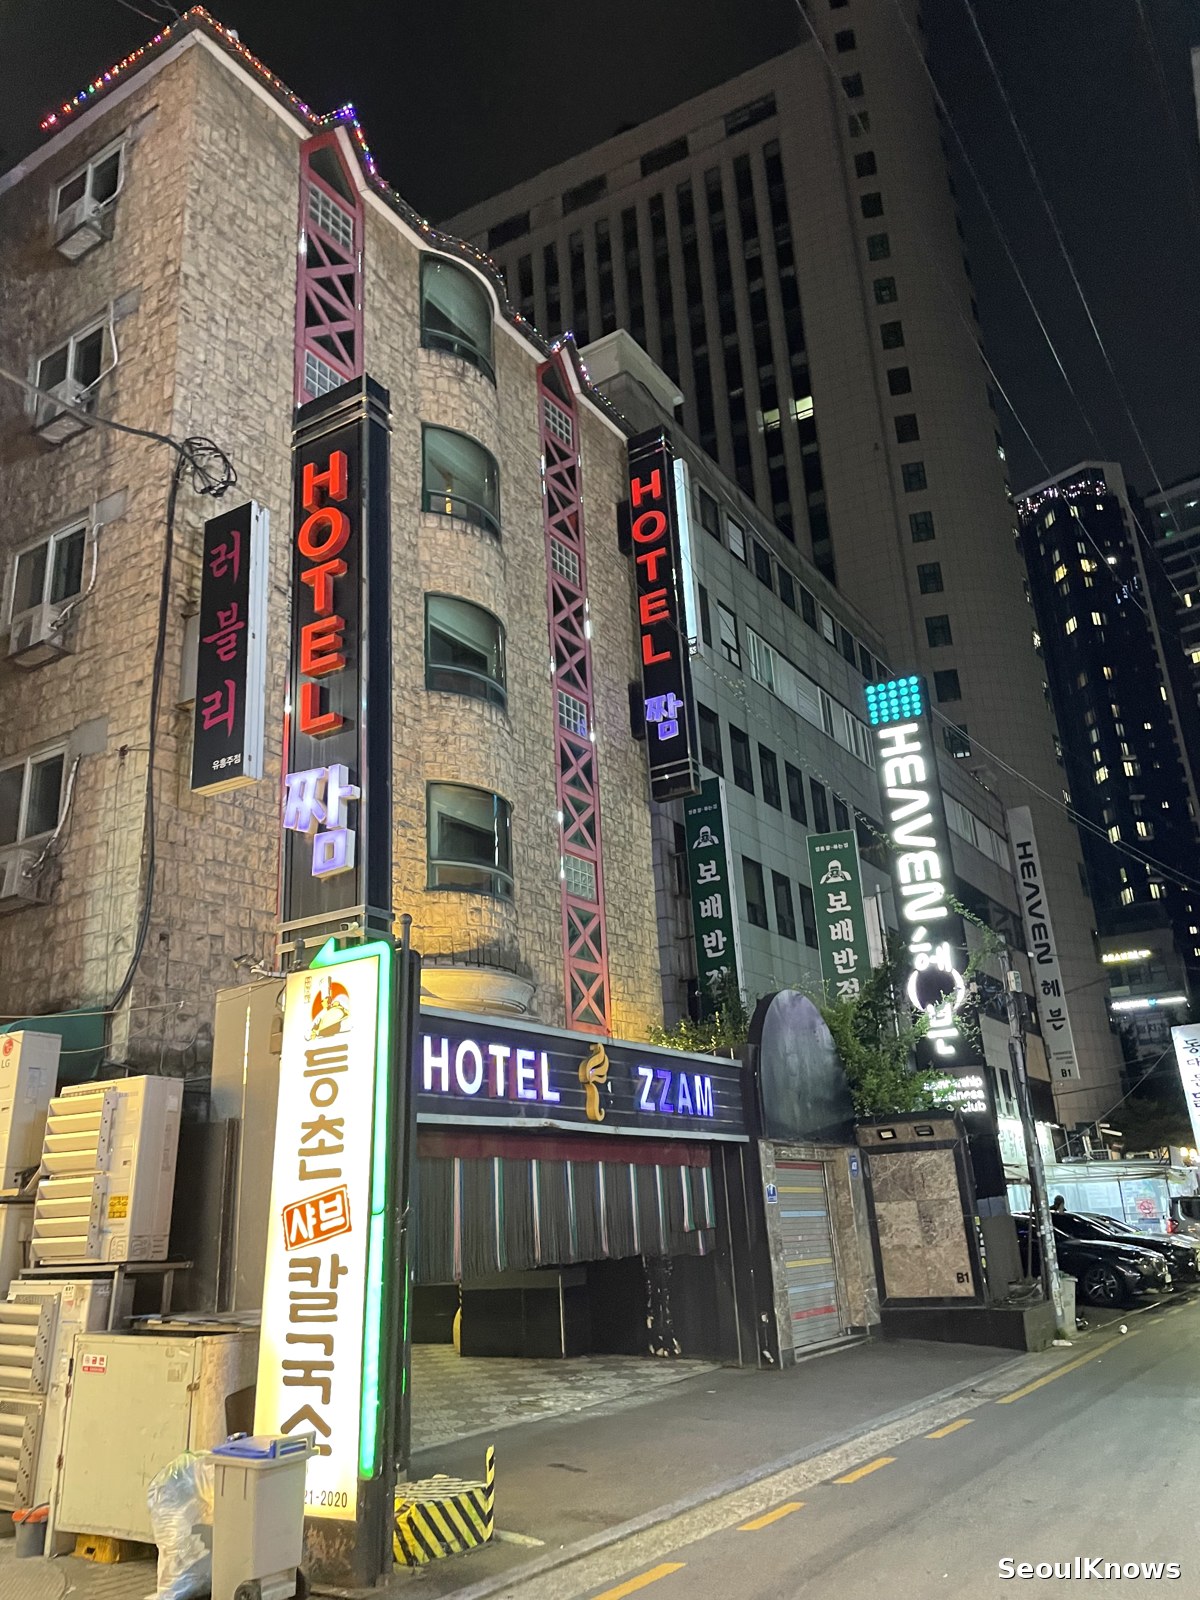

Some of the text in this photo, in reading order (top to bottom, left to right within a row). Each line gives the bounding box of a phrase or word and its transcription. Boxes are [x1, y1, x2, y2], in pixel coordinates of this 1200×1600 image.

[202, 530, 246, 737] 러블리
[282, 450, 361, 878] HOTEL 짬
[630, 468, 684, 742] HOTEL 짬
[877, 722, 948, 921] HEAVEN
[1016, 841, 1053, 965] HEAVEN
[1, 1059, 10, 1068] LG
[298, 1044, 349, 1181] 등촌
[423, 1035, 714, 1117] HOTEL ZZAM
[1060, 1068, 1072, 1077] B1
[290, 1193, 345, 1243] 샤브
[956, 1272, 970, 1284] B1
